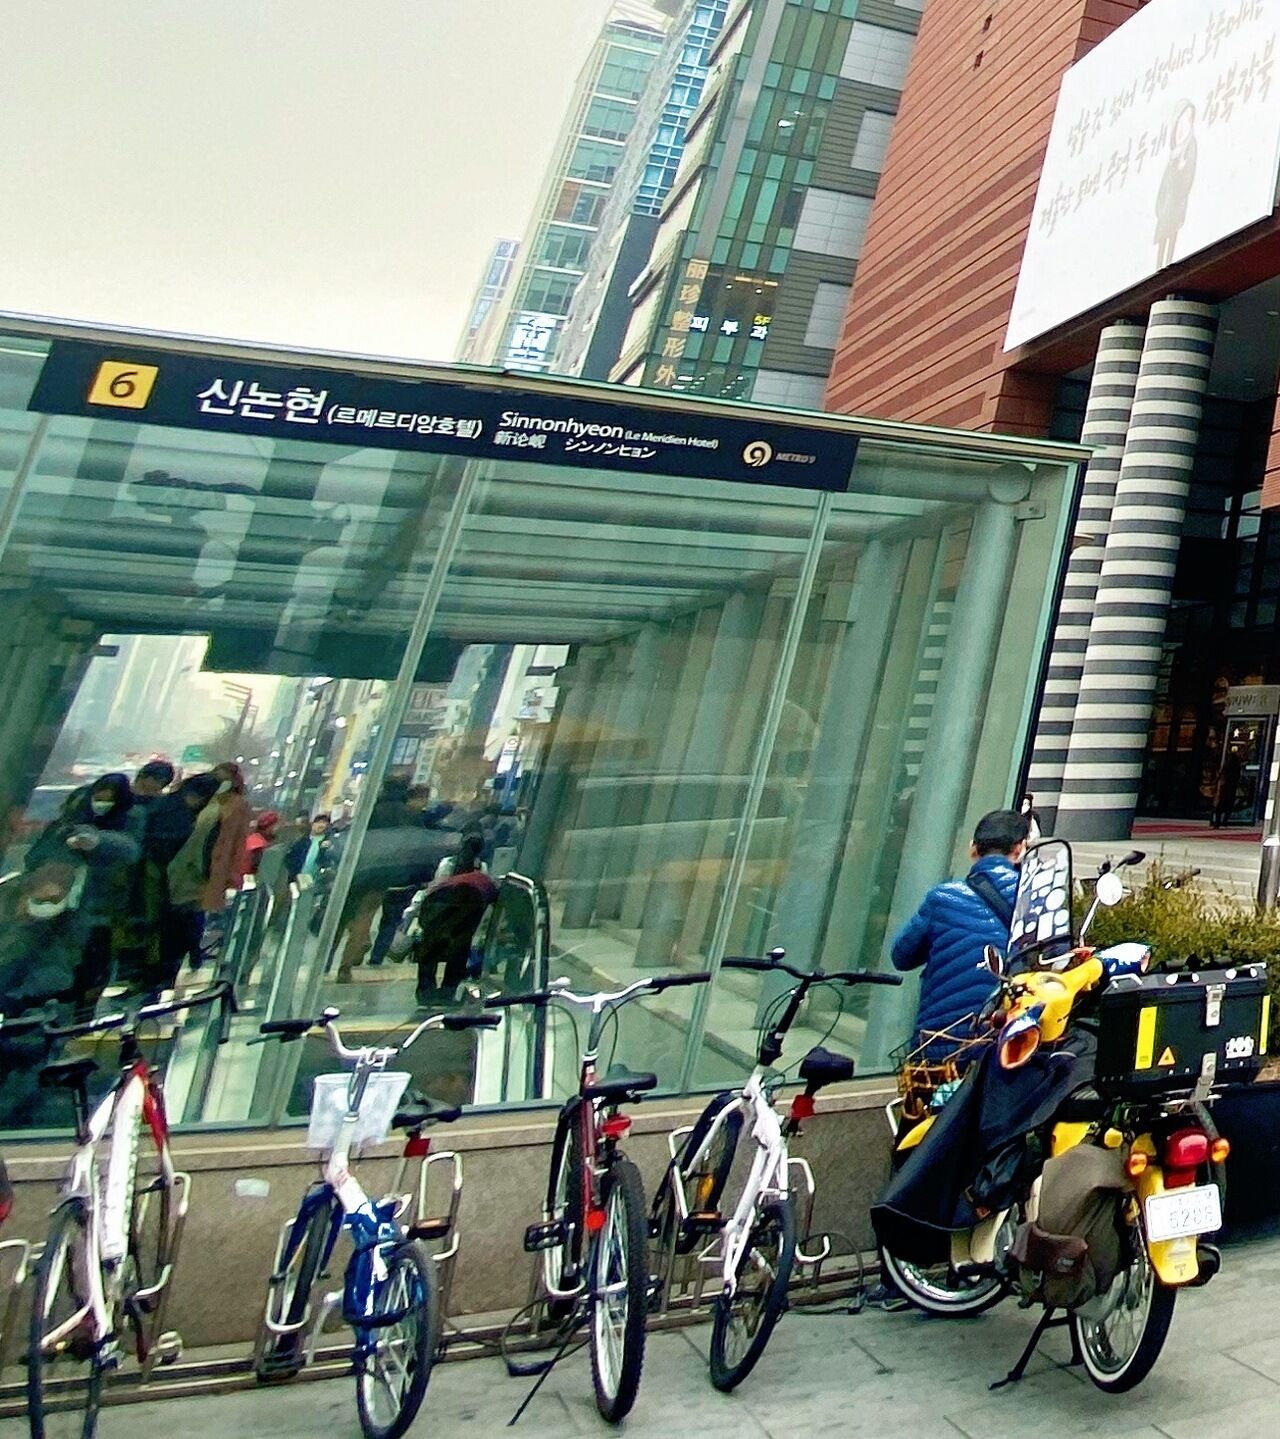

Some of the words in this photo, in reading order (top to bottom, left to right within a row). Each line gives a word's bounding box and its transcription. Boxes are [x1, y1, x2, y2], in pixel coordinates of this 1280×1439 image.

[109, 371, 138, 398] 6
[197, 378, 327, 425] 신논현
[327, 404, 483, 440] (르메르디앙호텔)
[499, 411, 624, 440] Sinnonhyeon
[624, 430, 641, 441] (Le
[641, 432, 687, 446] Meridien
[687, 436, 719, 450] Hotel)
[564, 437, 657, 459] シンノンヒョン
